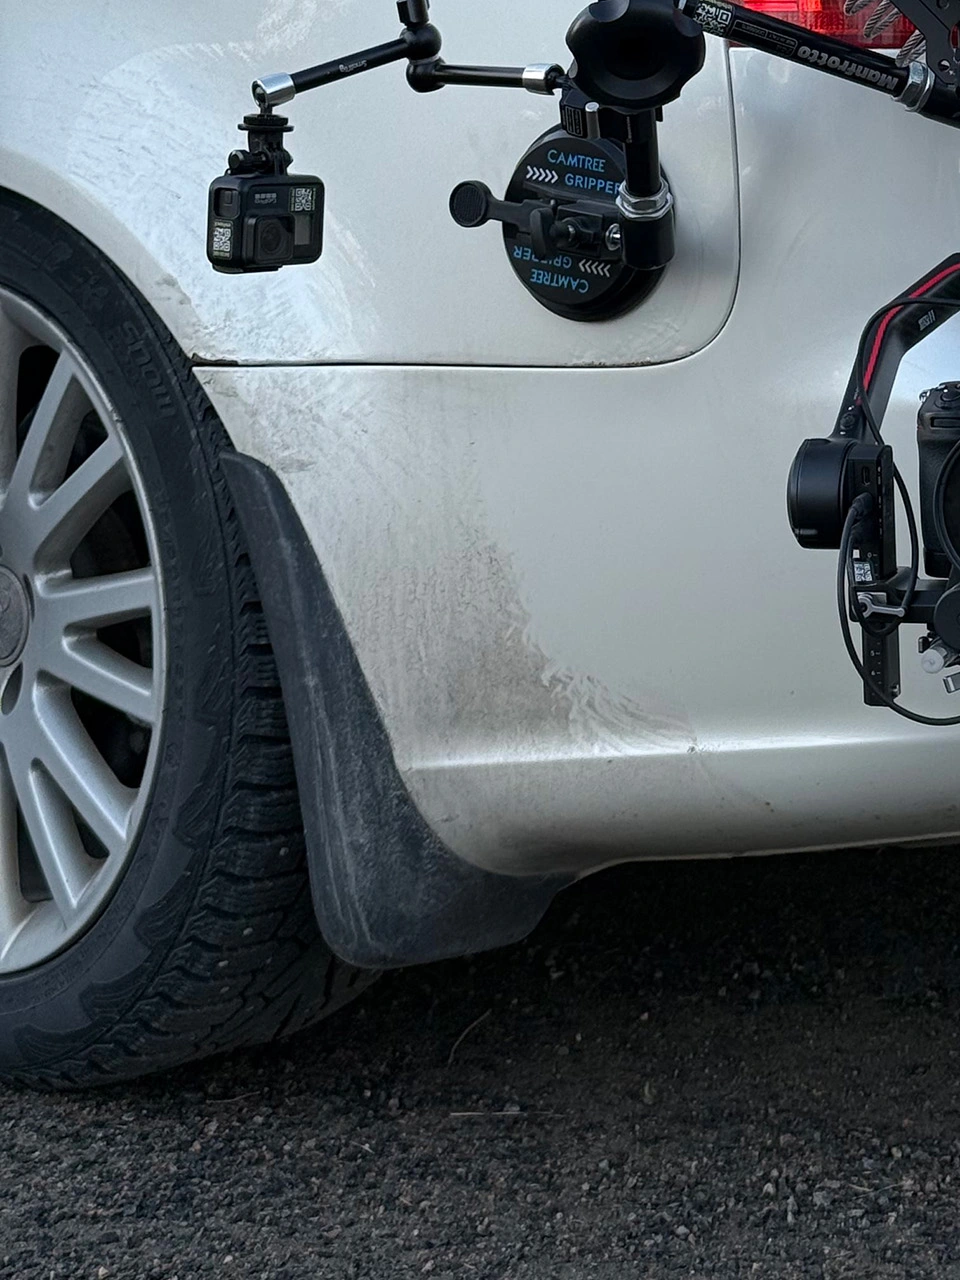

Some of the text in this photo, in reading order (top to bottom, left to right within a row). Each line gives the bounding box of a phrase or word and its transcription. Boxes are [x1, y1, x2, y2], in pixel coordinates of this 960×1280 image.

[797, 45, 899, 90] Manfrotto
[547, 149, 606, 173] CAMTREE
[514, 244, 573, 269] GRER
[529, 268, 590, 293] CAMTREE
